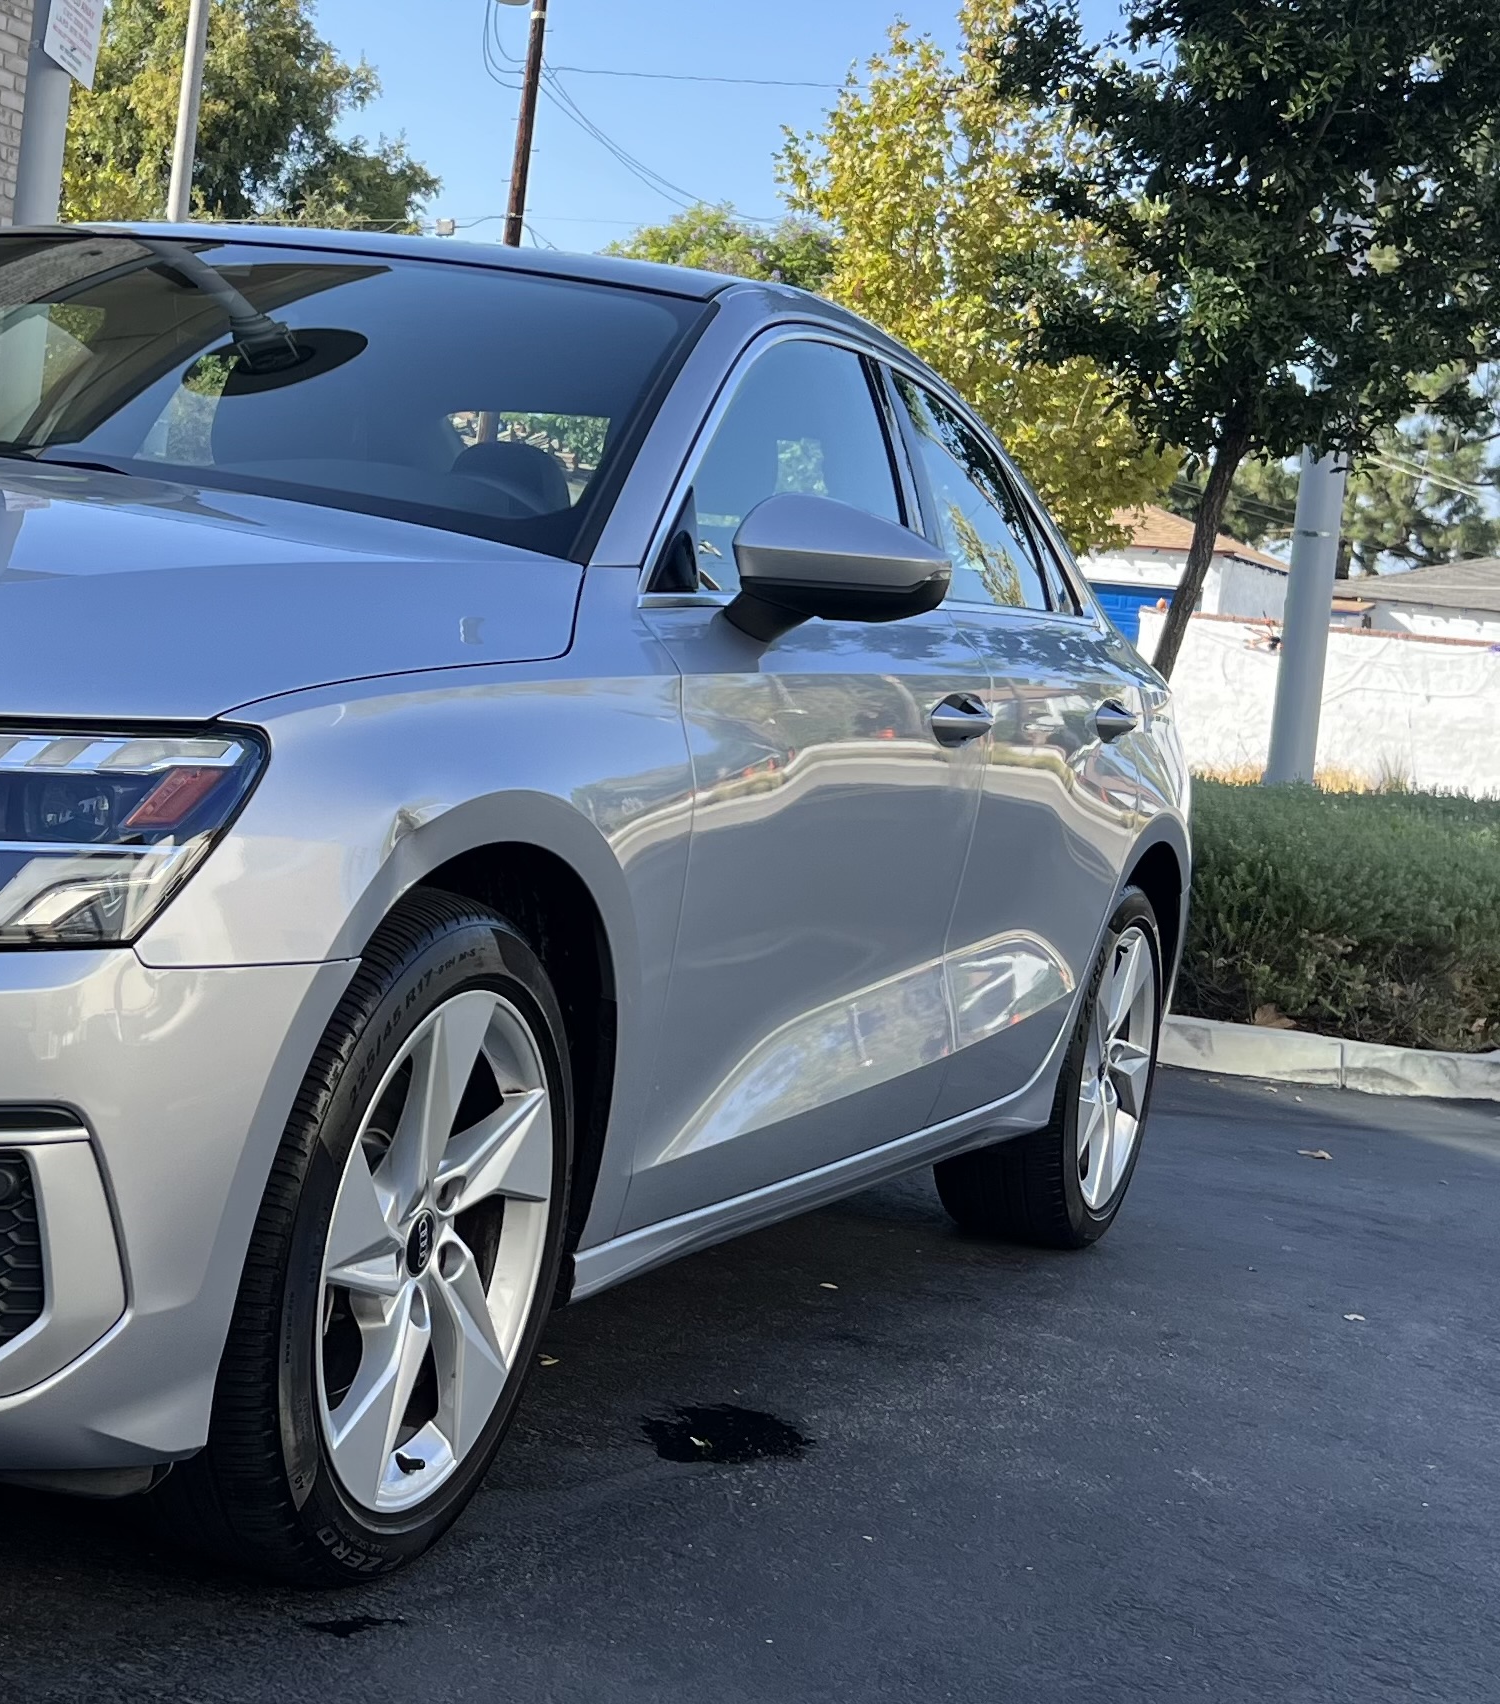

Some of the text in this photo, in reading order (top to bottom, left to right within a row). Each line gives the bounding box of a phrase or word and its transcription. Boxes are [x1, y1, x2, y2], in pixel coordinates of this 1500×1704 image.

[349, 1004, 402, 1110] 225/45
[405, 968, 433, 1010] R17
[316, 1525, 383, 1572] ZERO
